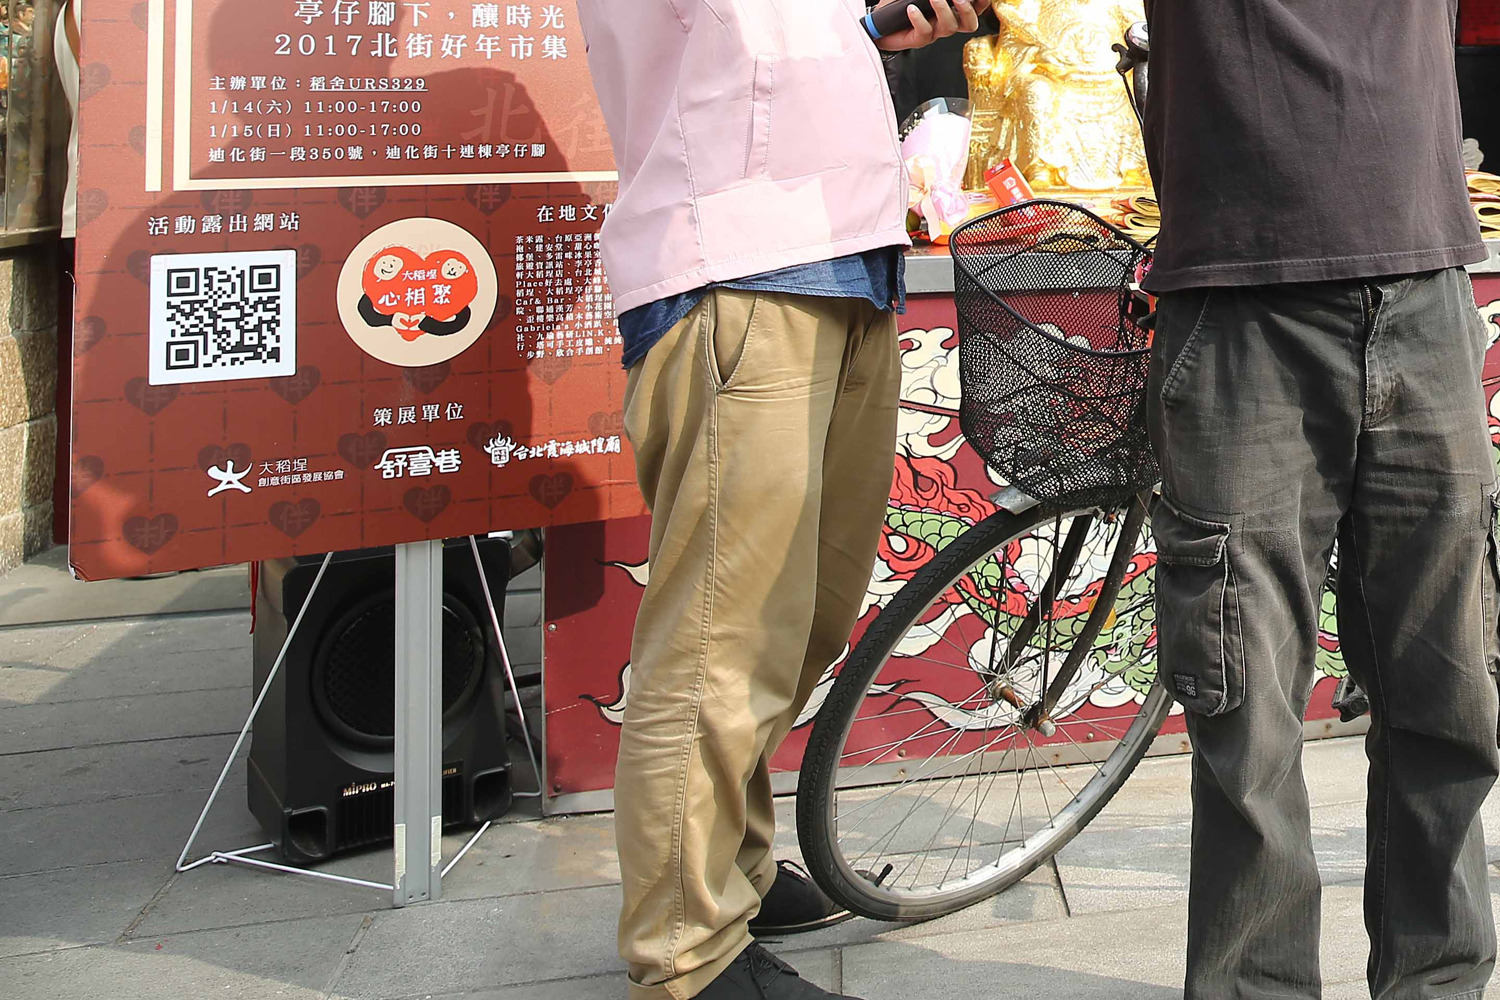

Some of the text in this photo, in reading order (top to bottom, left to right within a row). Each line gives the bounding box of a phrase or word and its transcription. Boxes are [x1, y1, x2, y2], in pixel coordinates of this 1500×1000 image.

[274, 32, 569, 60] 2017北街好年市集
[303, 100, 422, 114] 11:00-17:00
[303, 123, 422, 137] 11:00-17:00
[147, 211, 300, 236] 活動露出網站
[378, 284, 452, 307] 心相聚
[373, 402, 464, 427] 策展單位
[513, 436, 621, 460] 台北霞海城隍廟
[259, 459, 308, 476] 大稻埕
[374, 446, 462, 479] 舒喜巷
[258, 469, 345, 487] 創意街區發展協會
